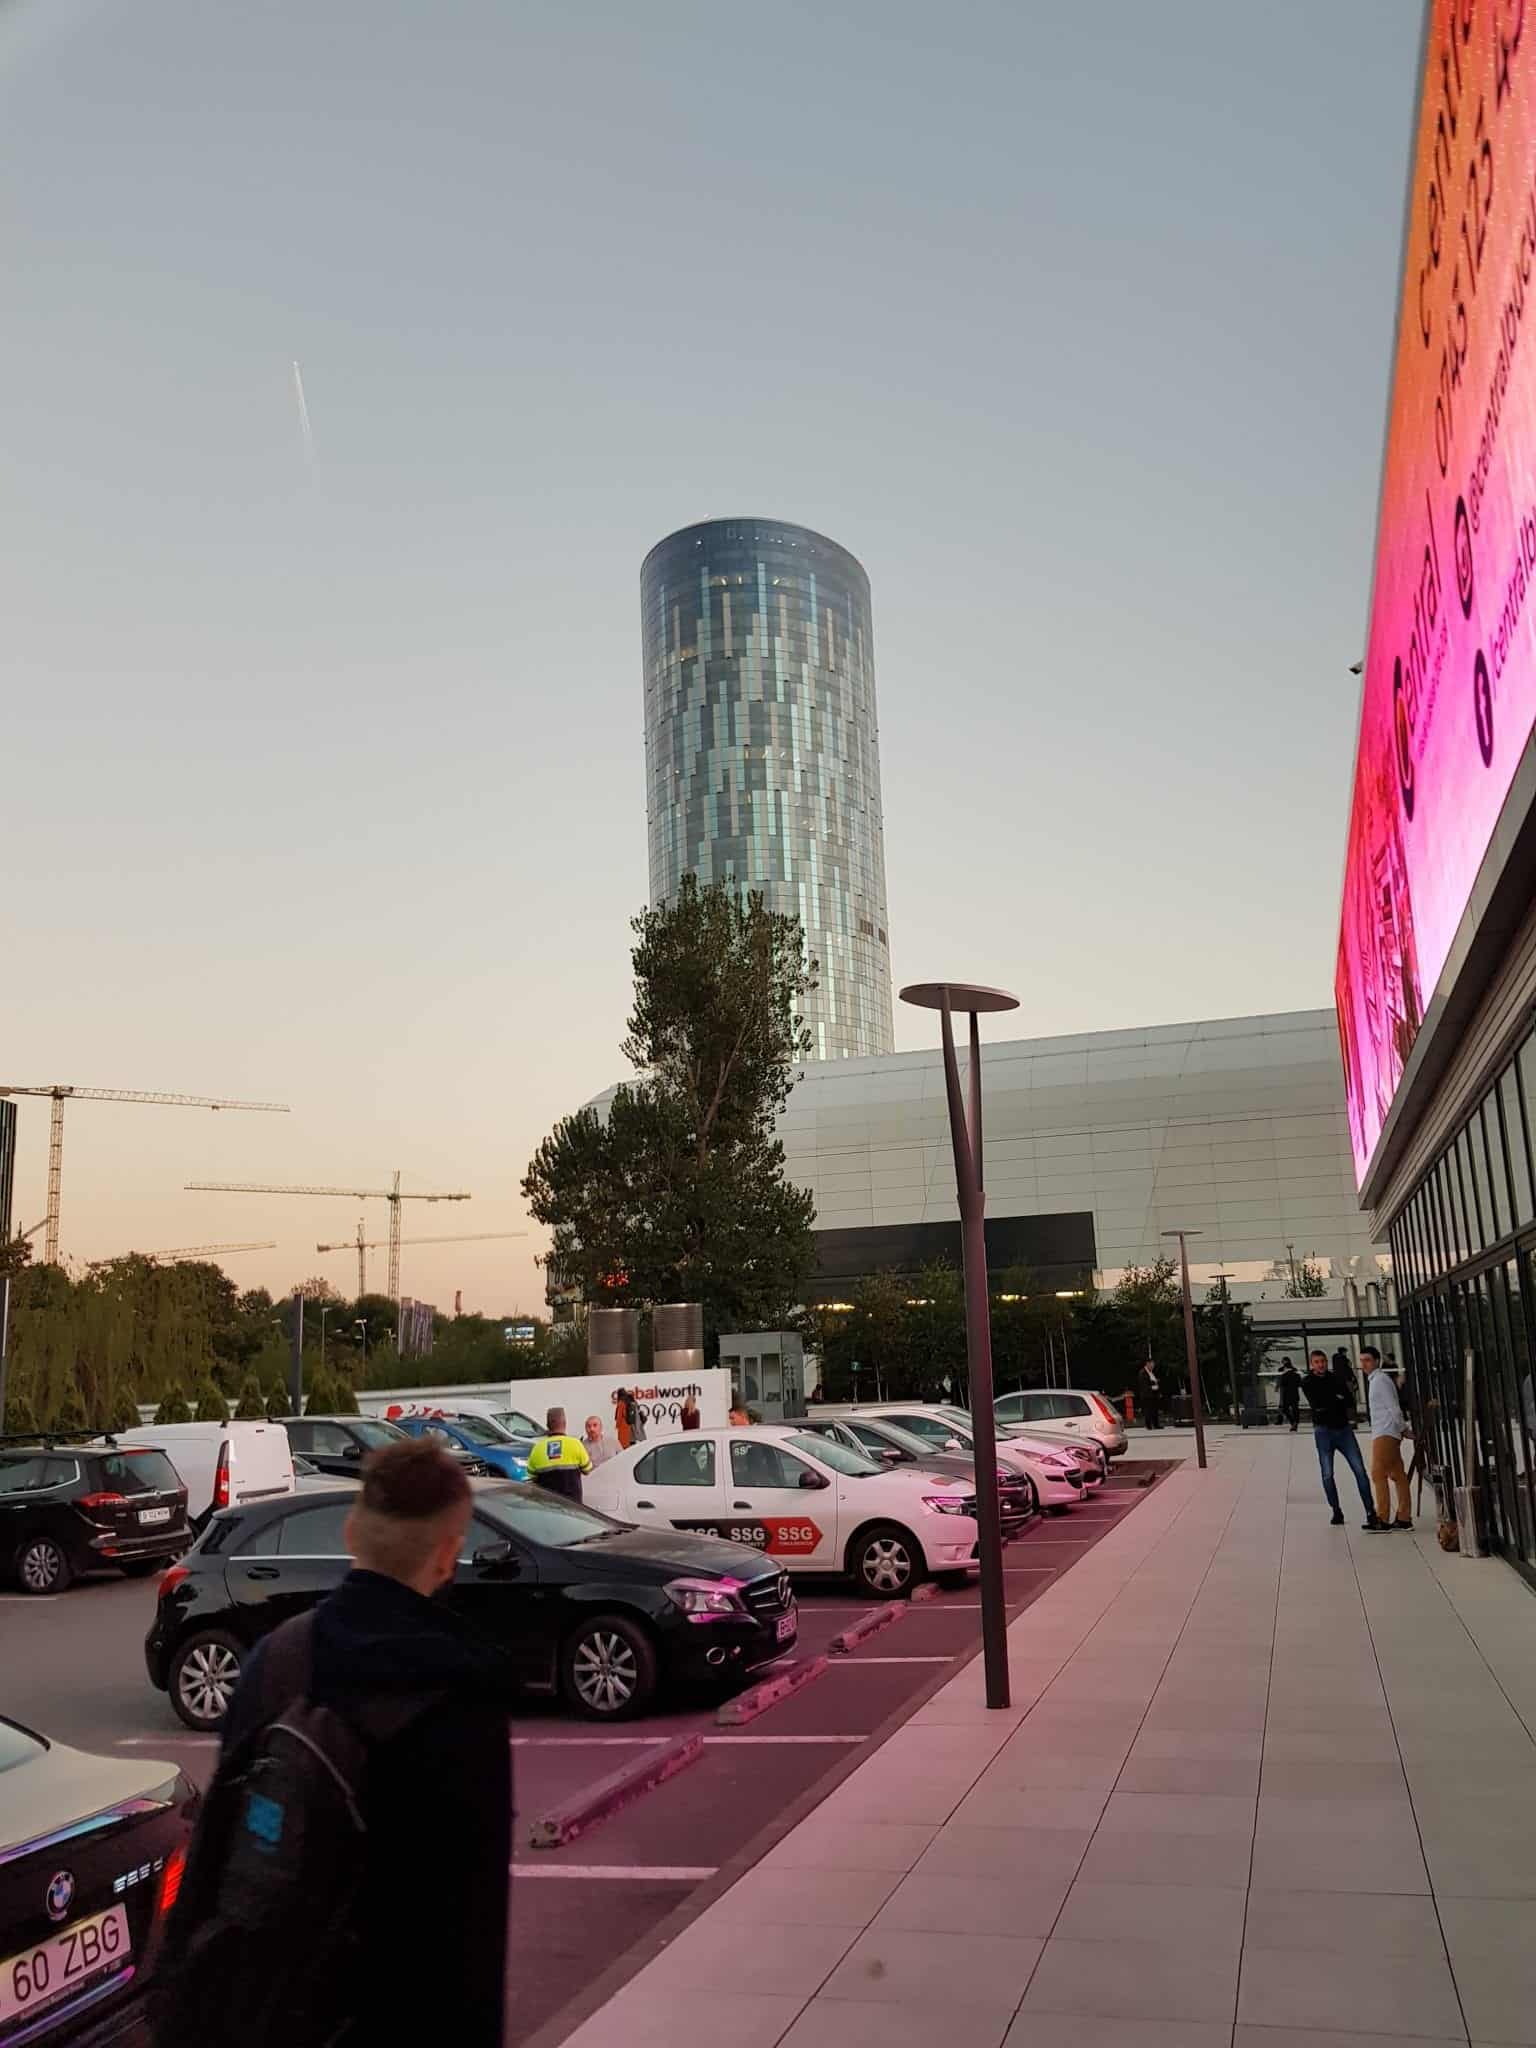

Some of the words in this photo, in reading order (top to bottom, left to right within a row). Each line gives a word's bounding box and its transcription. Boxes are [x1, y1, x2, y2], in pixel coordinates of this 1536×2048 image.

[611, 1383, 702, 1405] gbalworth
[730, 1527, 765, 1541] SSG
[777, 1526, 813, 1541] SSG
[12, 1950, 50, 2002] 60
[59, 1914, 120, 1980] ZBG
